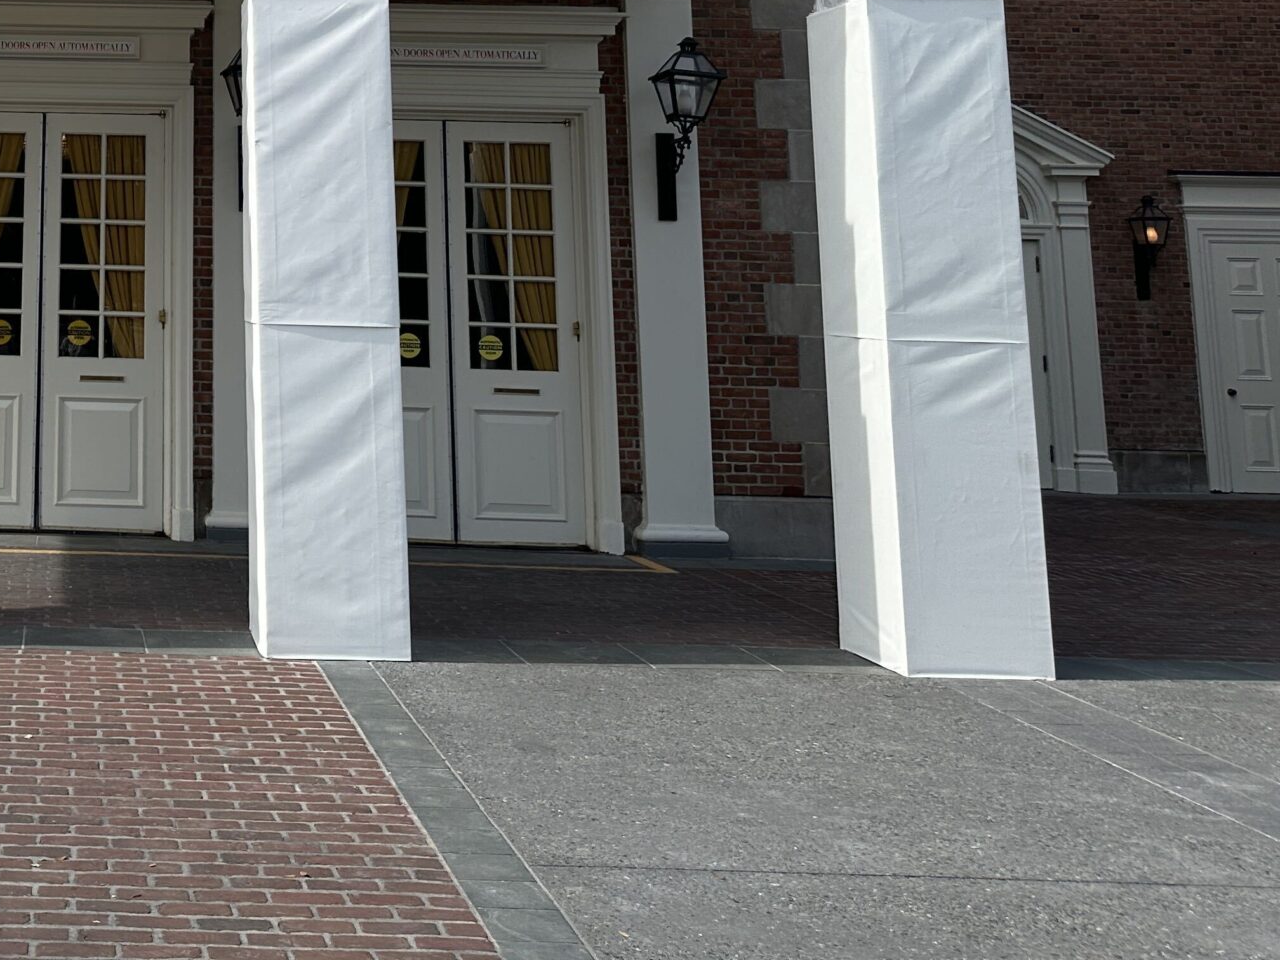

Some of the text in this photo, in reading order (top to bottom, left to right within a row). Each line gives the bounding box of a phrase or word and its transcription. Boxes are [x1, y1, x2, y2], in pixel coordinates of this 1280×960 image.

[1, 41, 31, 50] DOORS
[32, 42, 55, 50] OPEN
[57, 42, 132, 52] AUTOMATICALLY
[403, 48, 434, 58] DOORS
[435, 49, 460, 58] OPEN
[461, 49, 538, 60] AUTOMATICALLY
